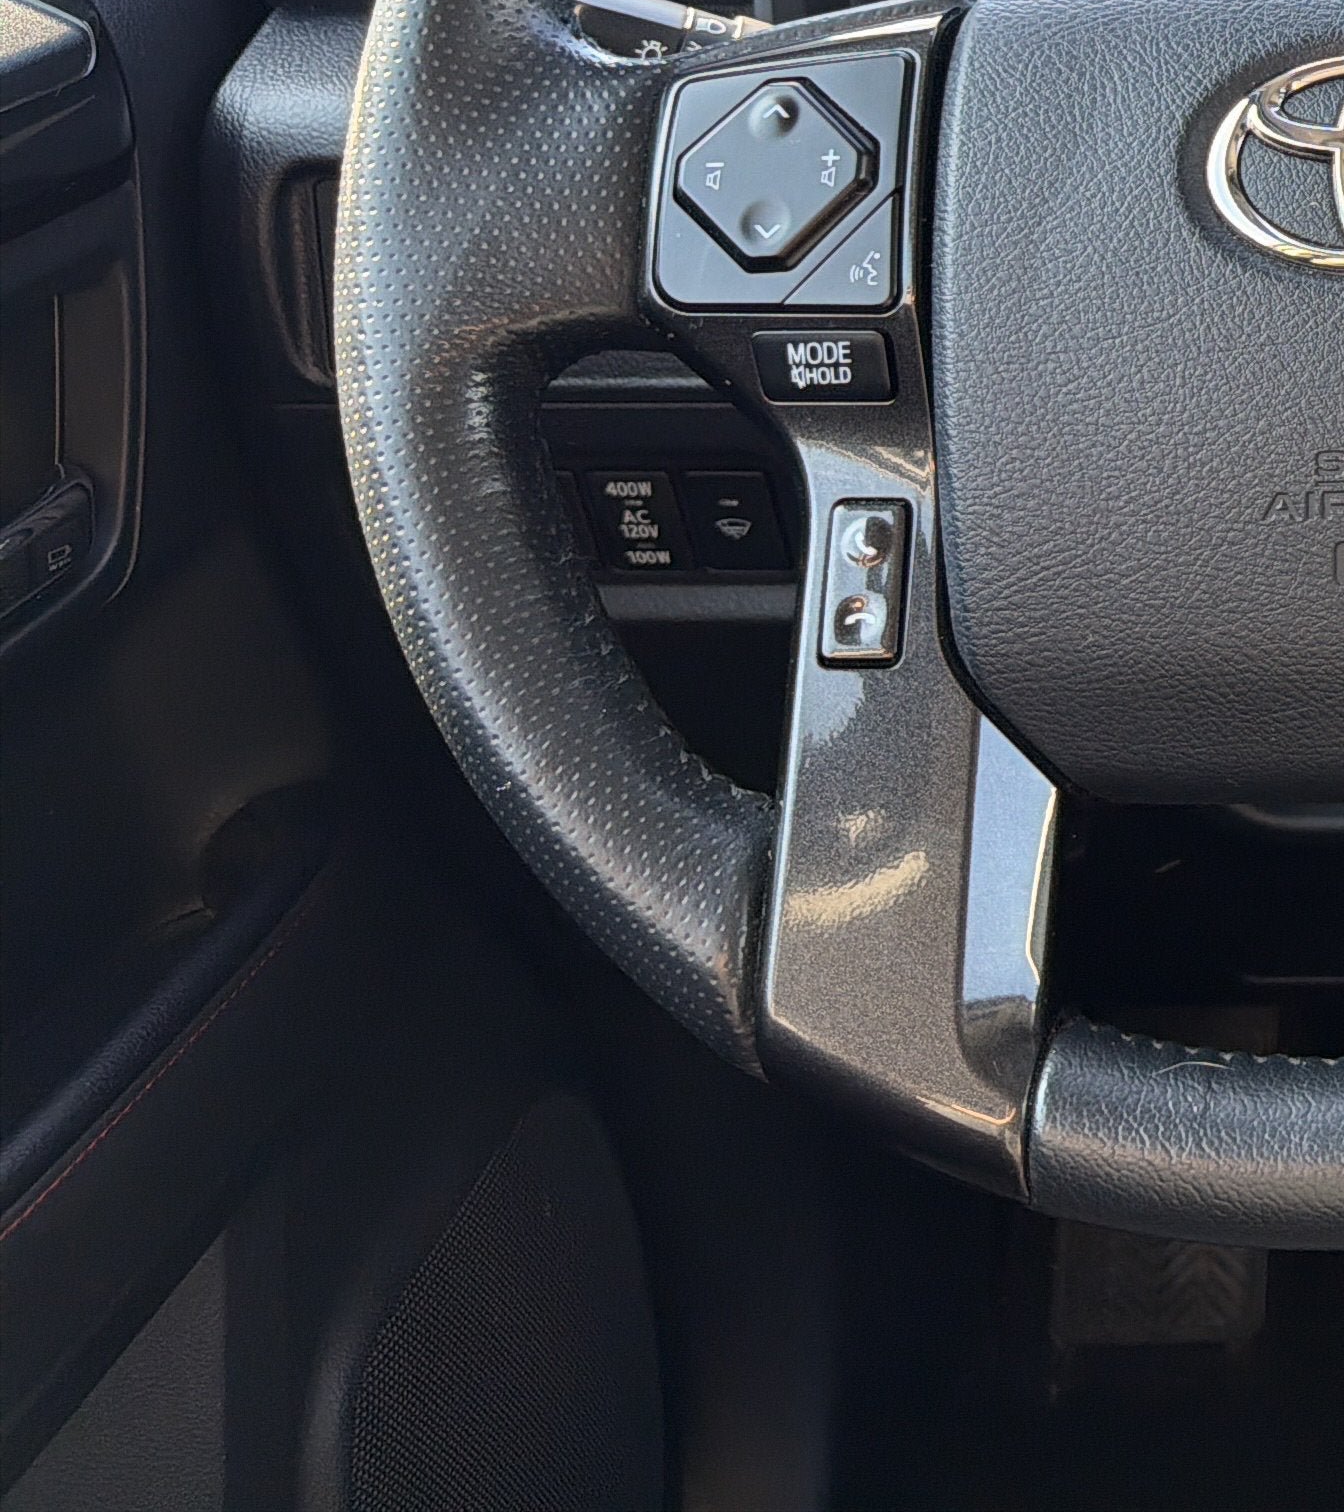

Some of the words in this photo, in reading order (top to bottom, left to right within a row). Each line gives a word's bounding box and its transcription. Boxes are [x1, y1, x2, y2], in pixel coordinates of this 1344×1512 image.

[787, 341, 852, 365] MODE
[805, 366, 852, 385] HOLD
[605, 481, 652, 497] 400W
[623, 509, 651, 524] AC
[619, 523, 659, 539] 120V
[625, 550, 671, 566] 100W
